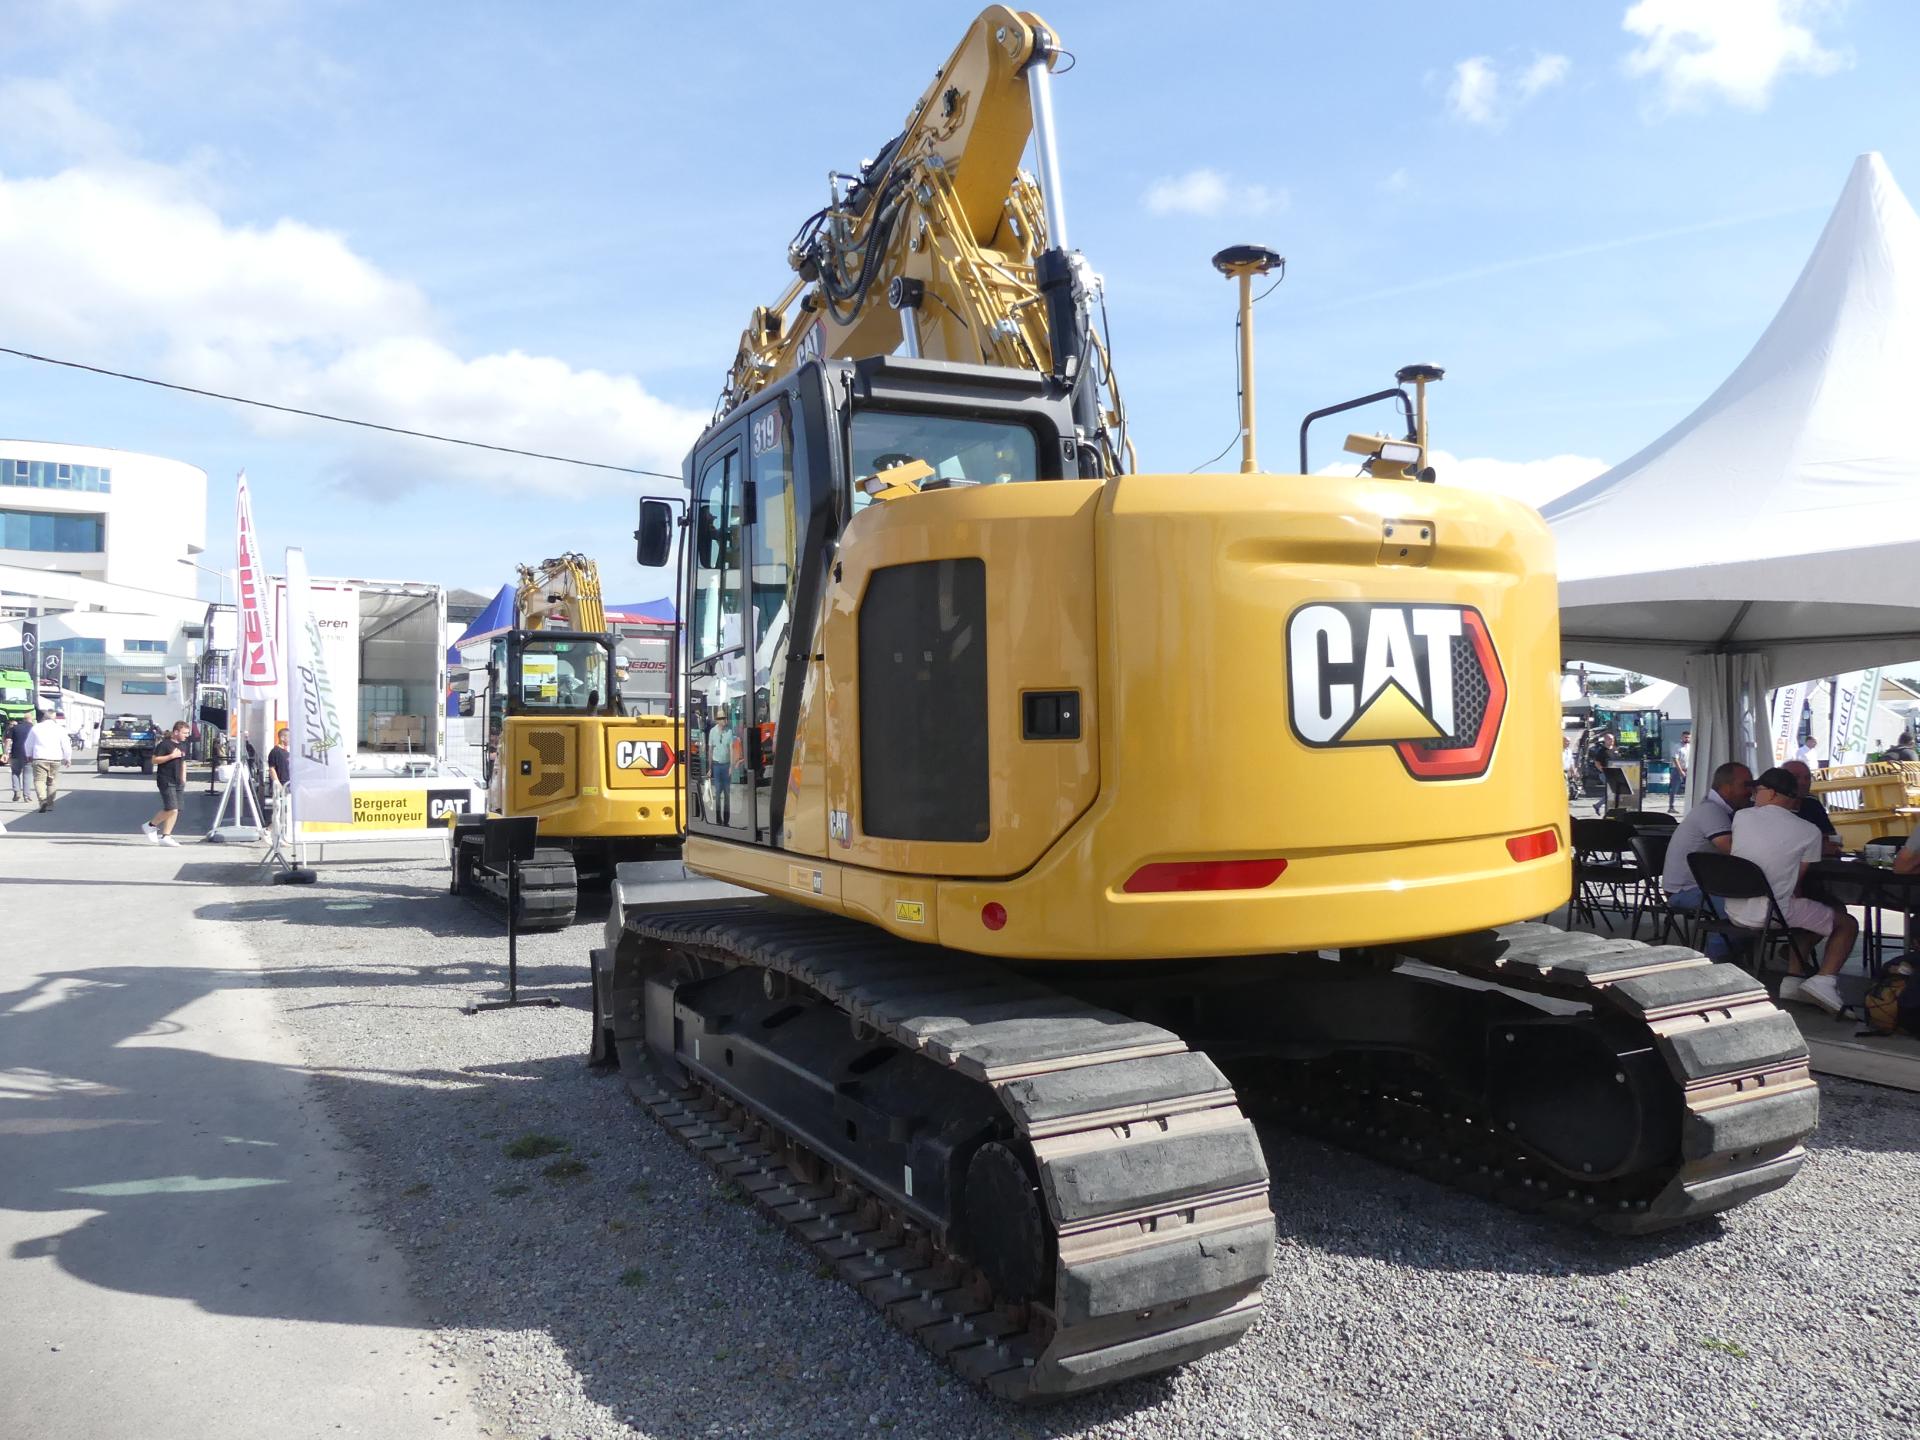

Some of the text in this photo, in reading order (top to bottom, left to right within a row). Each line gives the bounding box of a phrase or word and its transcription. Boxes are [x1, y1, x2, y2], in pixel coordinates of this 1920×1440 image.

[753, 414, 775, 454] 319
[318, 619, 348, 629] eren
[1290, 605, 1463, 742] CAT
[297, 665, 323, 765] Evrard
[1832, 688, 1853, 762] Evrard
[1850, 669, 1874, 753] Sprima
[617, 741, 662, 769] CAT
[353, 797, 407, 810] Bergerat
[353, 811, 423, 823] Monnoyeur
[431, 799, 467, 819] CAT
[830, 810, 848, 840] CAT
